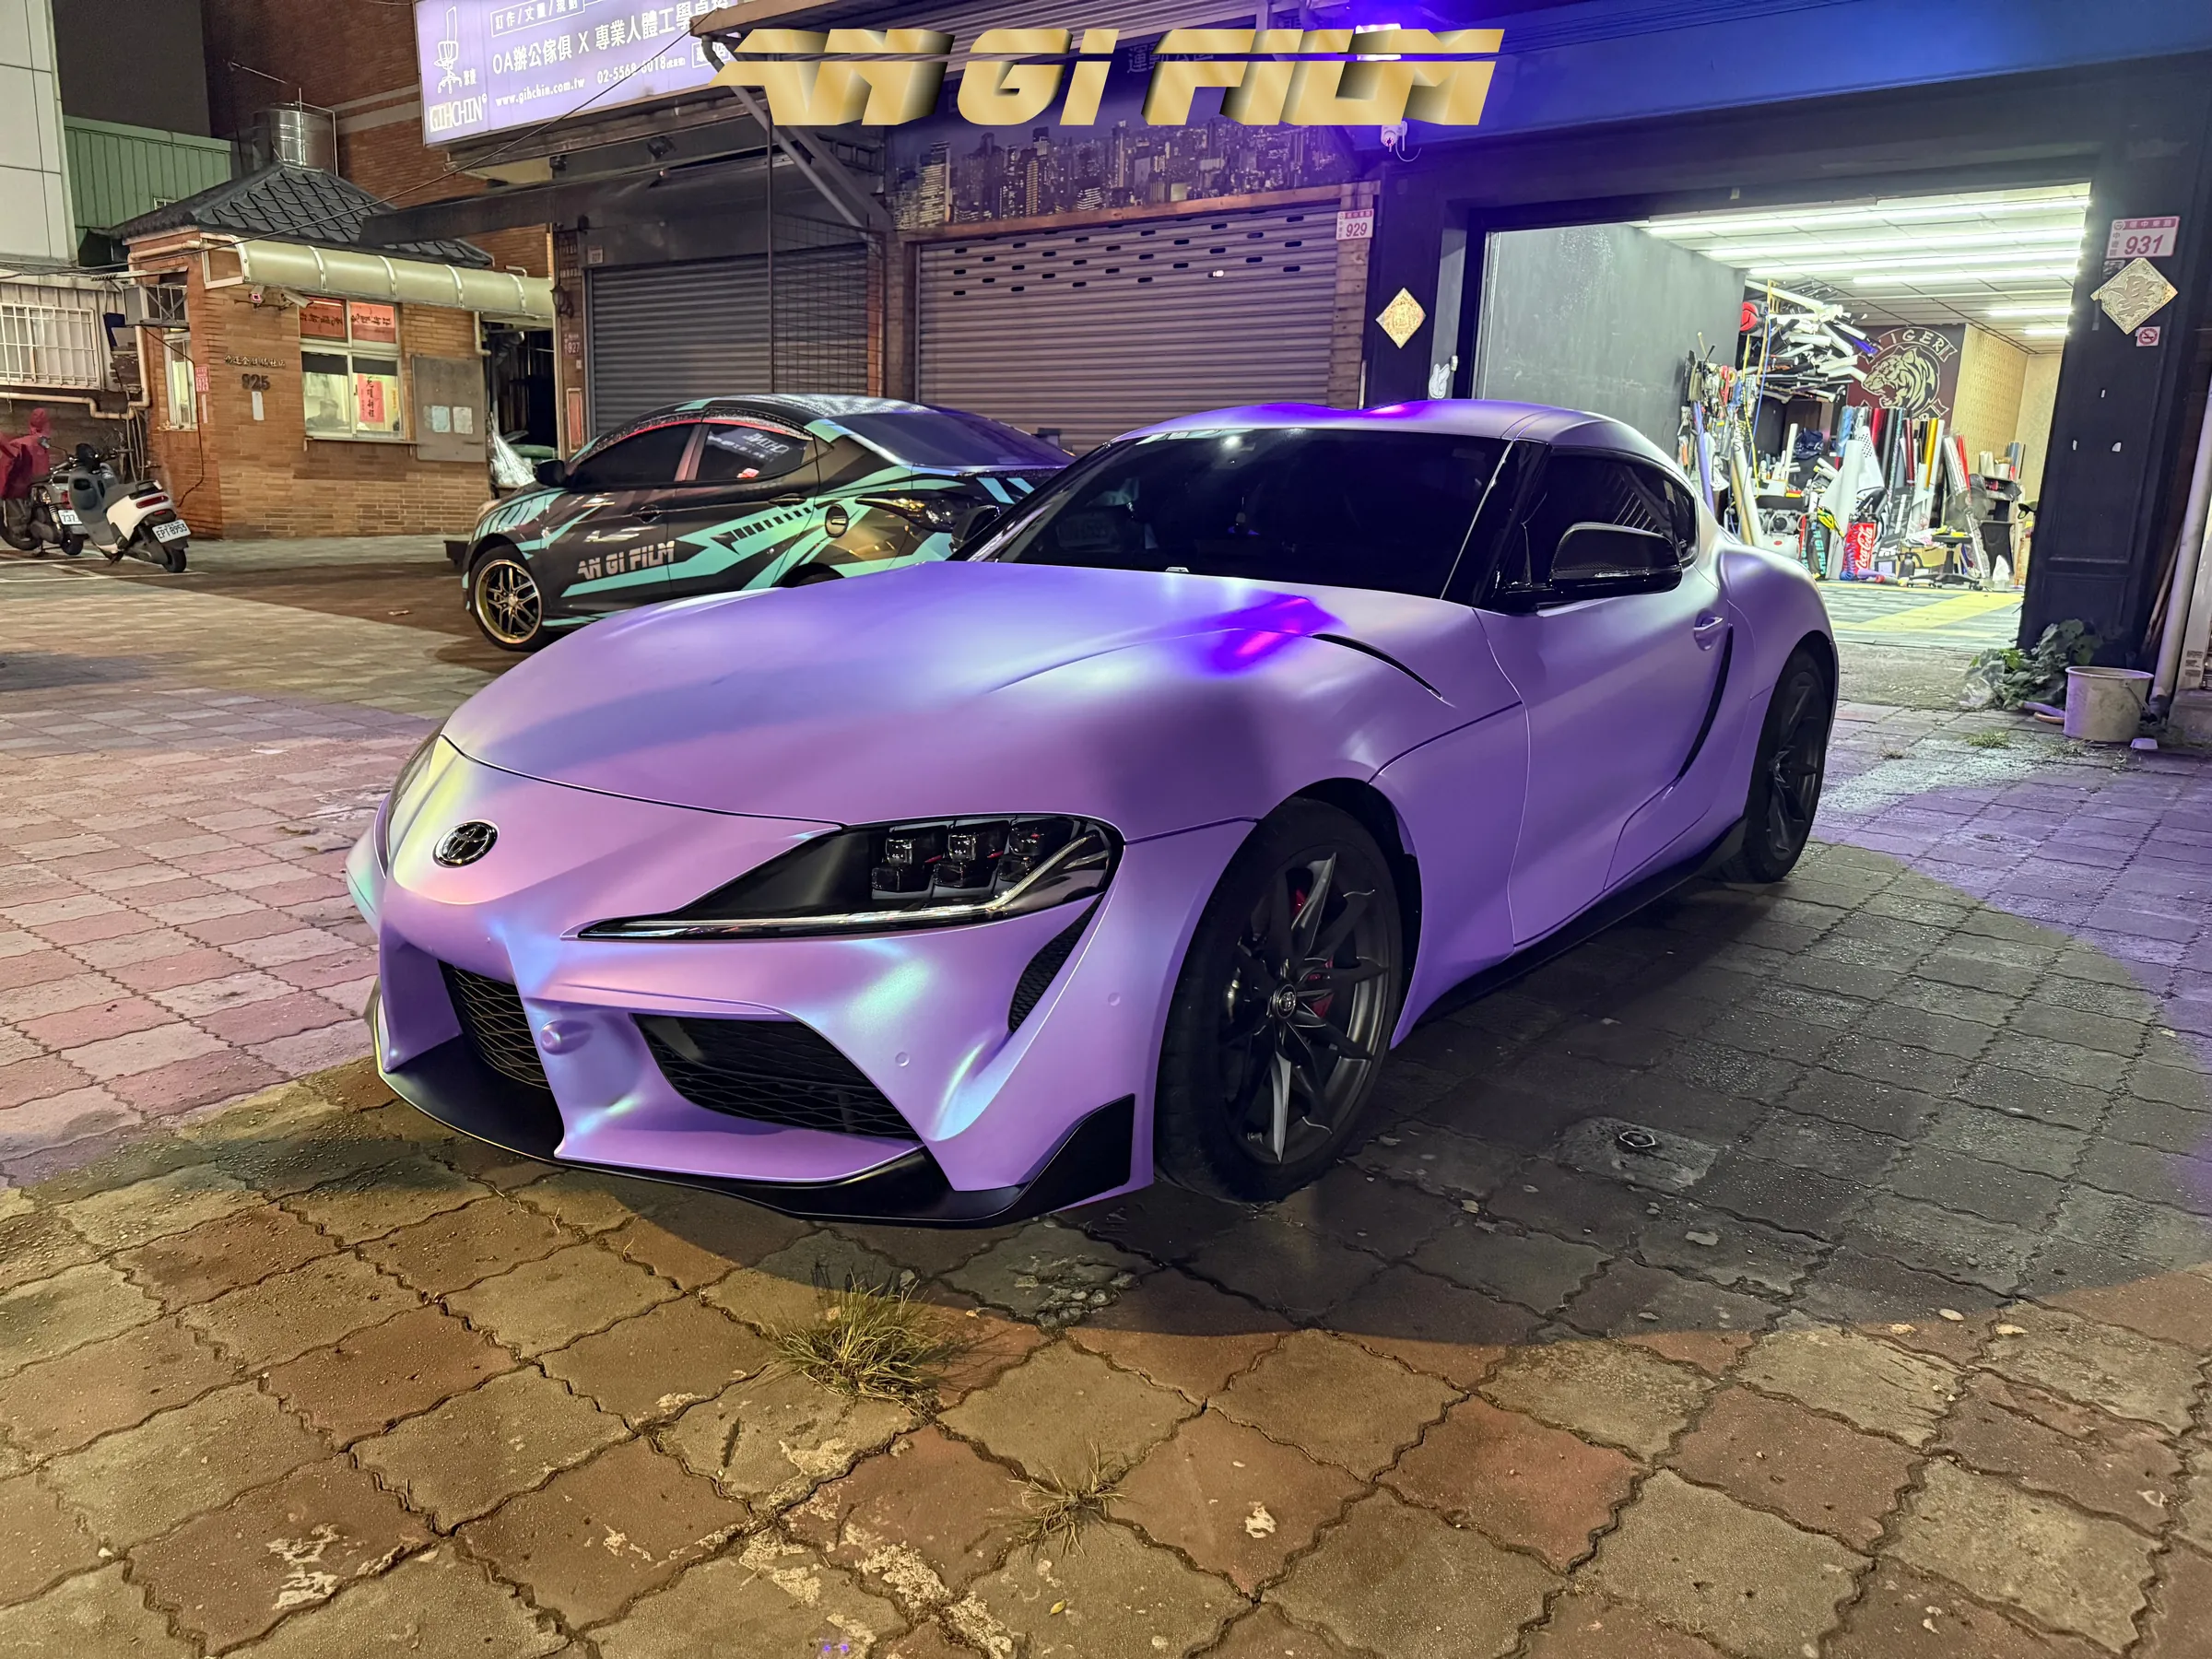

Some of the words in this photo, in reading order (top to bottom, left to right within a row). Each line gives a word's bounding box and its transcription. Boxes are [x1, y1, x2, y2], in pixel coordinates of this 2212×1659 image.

[594, 0, 729, 51] 專業人體工學
[495, 77, 585, 107] www.gihchin.com.tw
[1346, 222, 1368, 238] 929
[2124, 234, 2164, 255] 931
[629, 540, 677, 571] FILM
